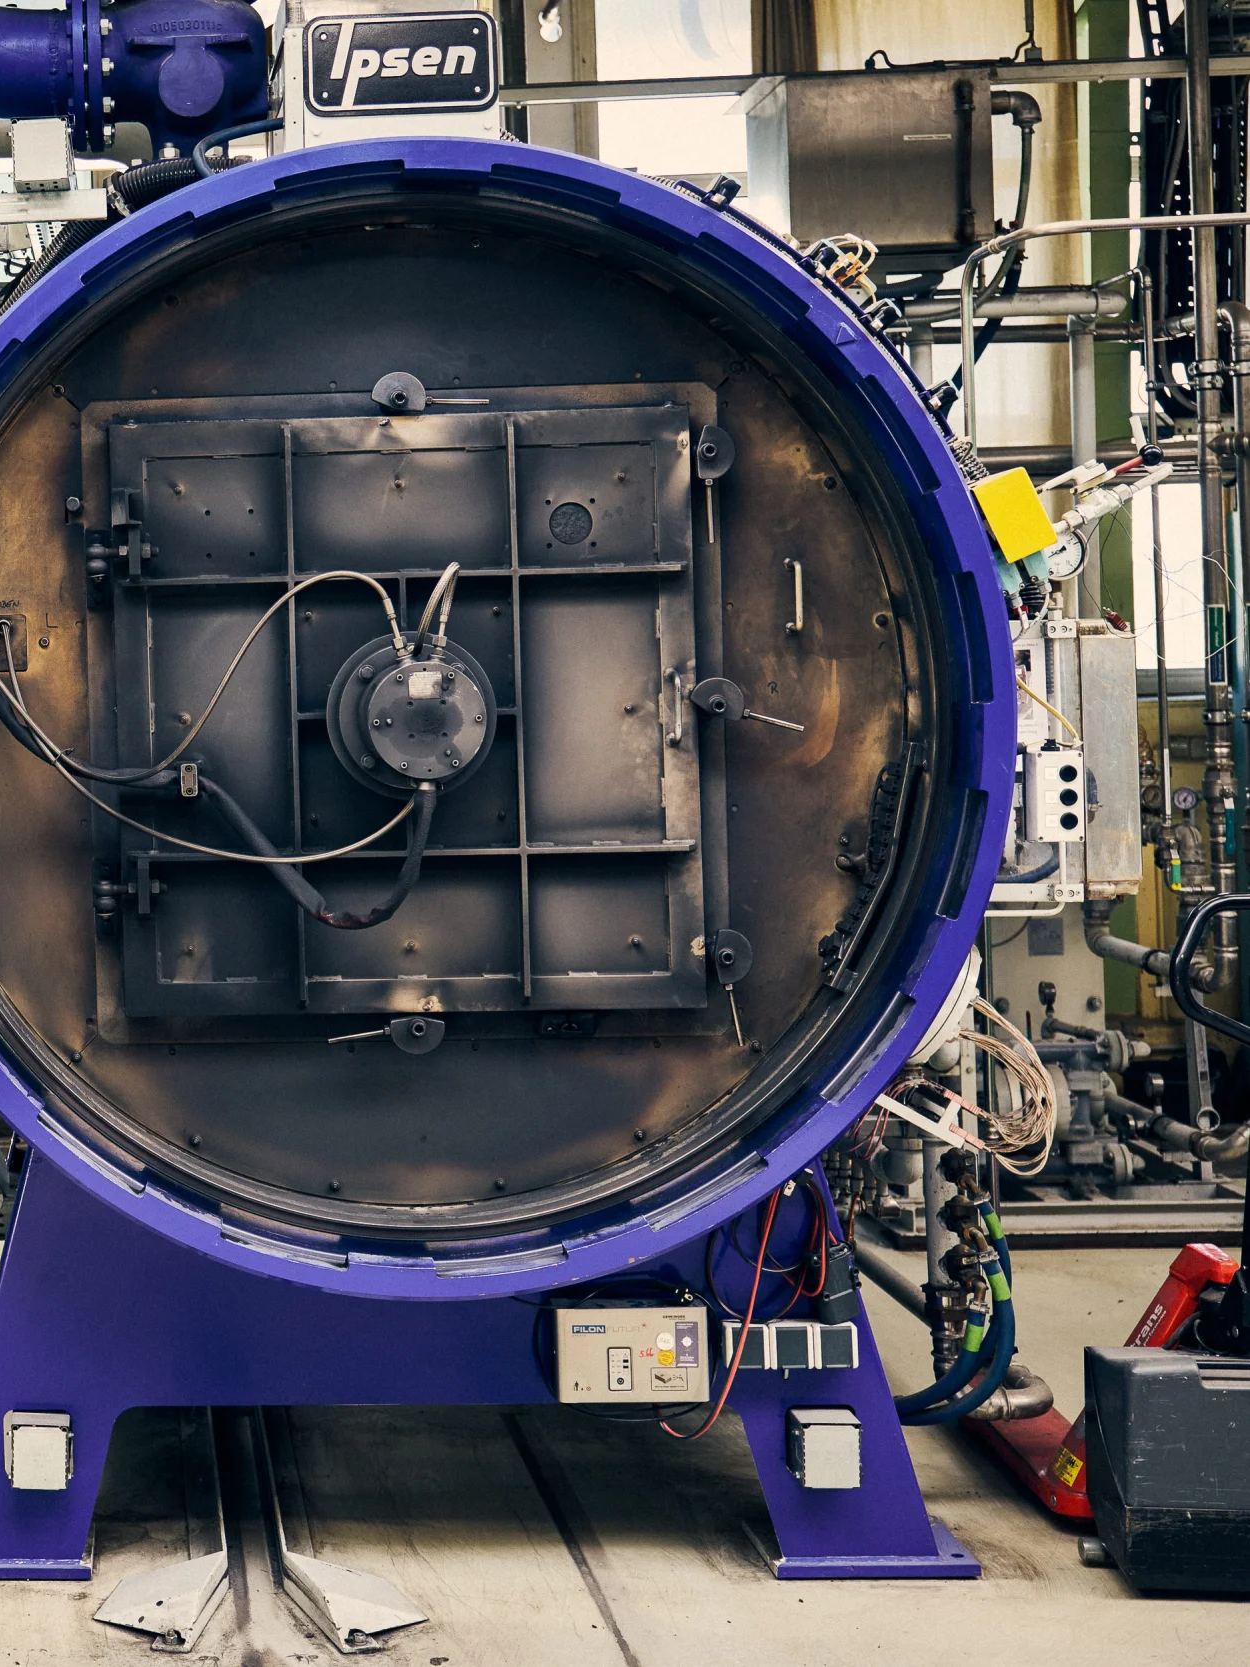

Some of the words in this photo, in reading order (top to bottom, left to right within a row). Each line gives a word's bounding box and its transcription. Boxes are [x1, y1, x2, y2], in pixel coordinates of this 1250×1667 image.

[329, 21, 478, 108] Ipsen
[45, 612, 59, 629] L
[766, 681, 779, 695] R
